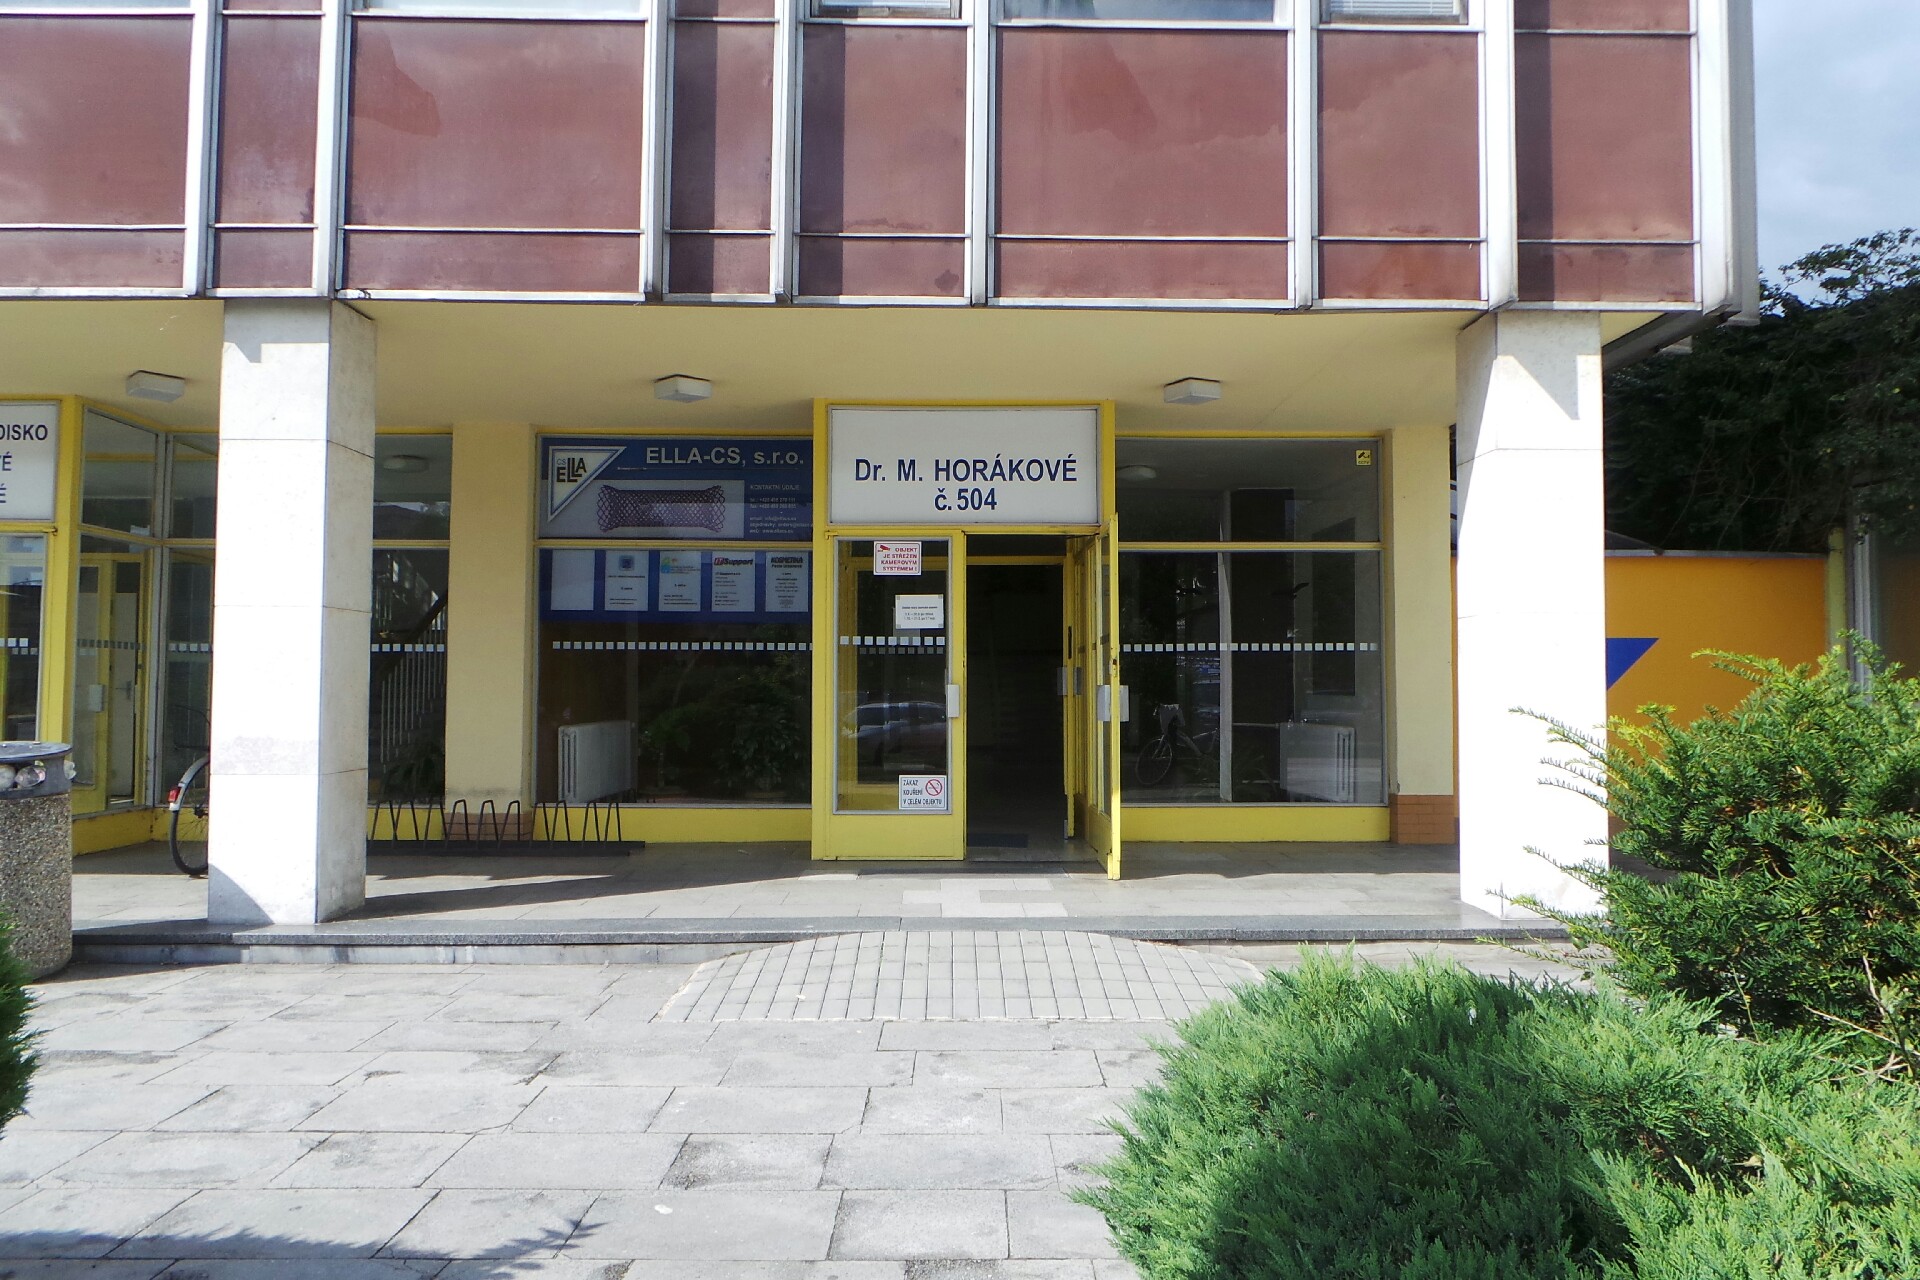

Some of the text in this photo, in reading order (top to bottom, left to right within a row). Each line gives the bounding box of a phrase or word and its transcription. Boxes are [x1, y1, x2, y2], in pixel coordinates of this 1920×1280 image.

[646, 447, 804, 467] ELLA-CS, s.r.o.
[855, 453, 1078, 482] Dr. M. HORÁKOVÉ
[556, 457, 587, 483] ELLA
[934, 487, 998, 511] č. 504
